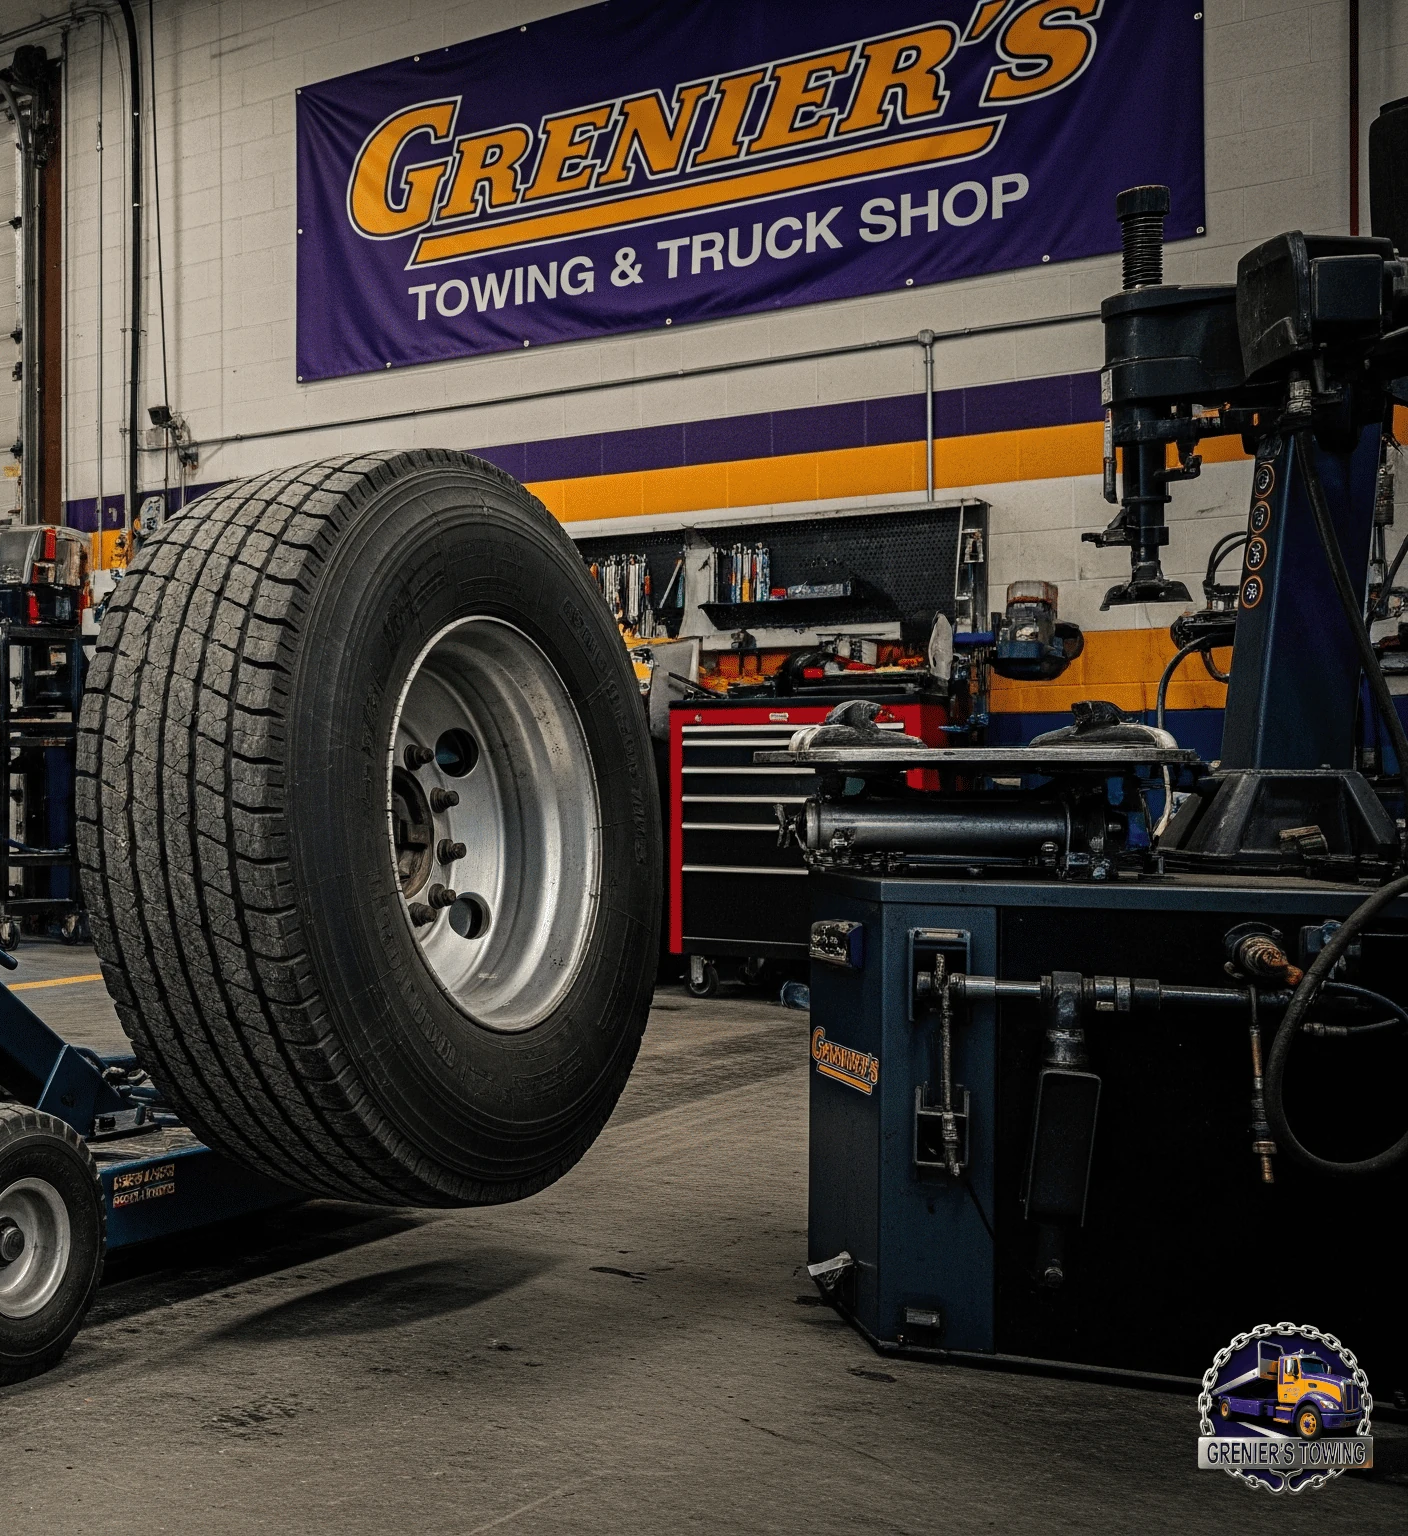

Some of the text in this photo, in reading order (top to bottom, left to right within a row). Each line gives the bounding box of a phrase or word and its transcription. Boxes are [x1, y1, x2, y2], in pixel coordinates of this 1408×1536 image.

[346, 0, 1105, 241] GRENIER'S
[407, 173, 1030, 321] TOWING & TRUCK SHOP
